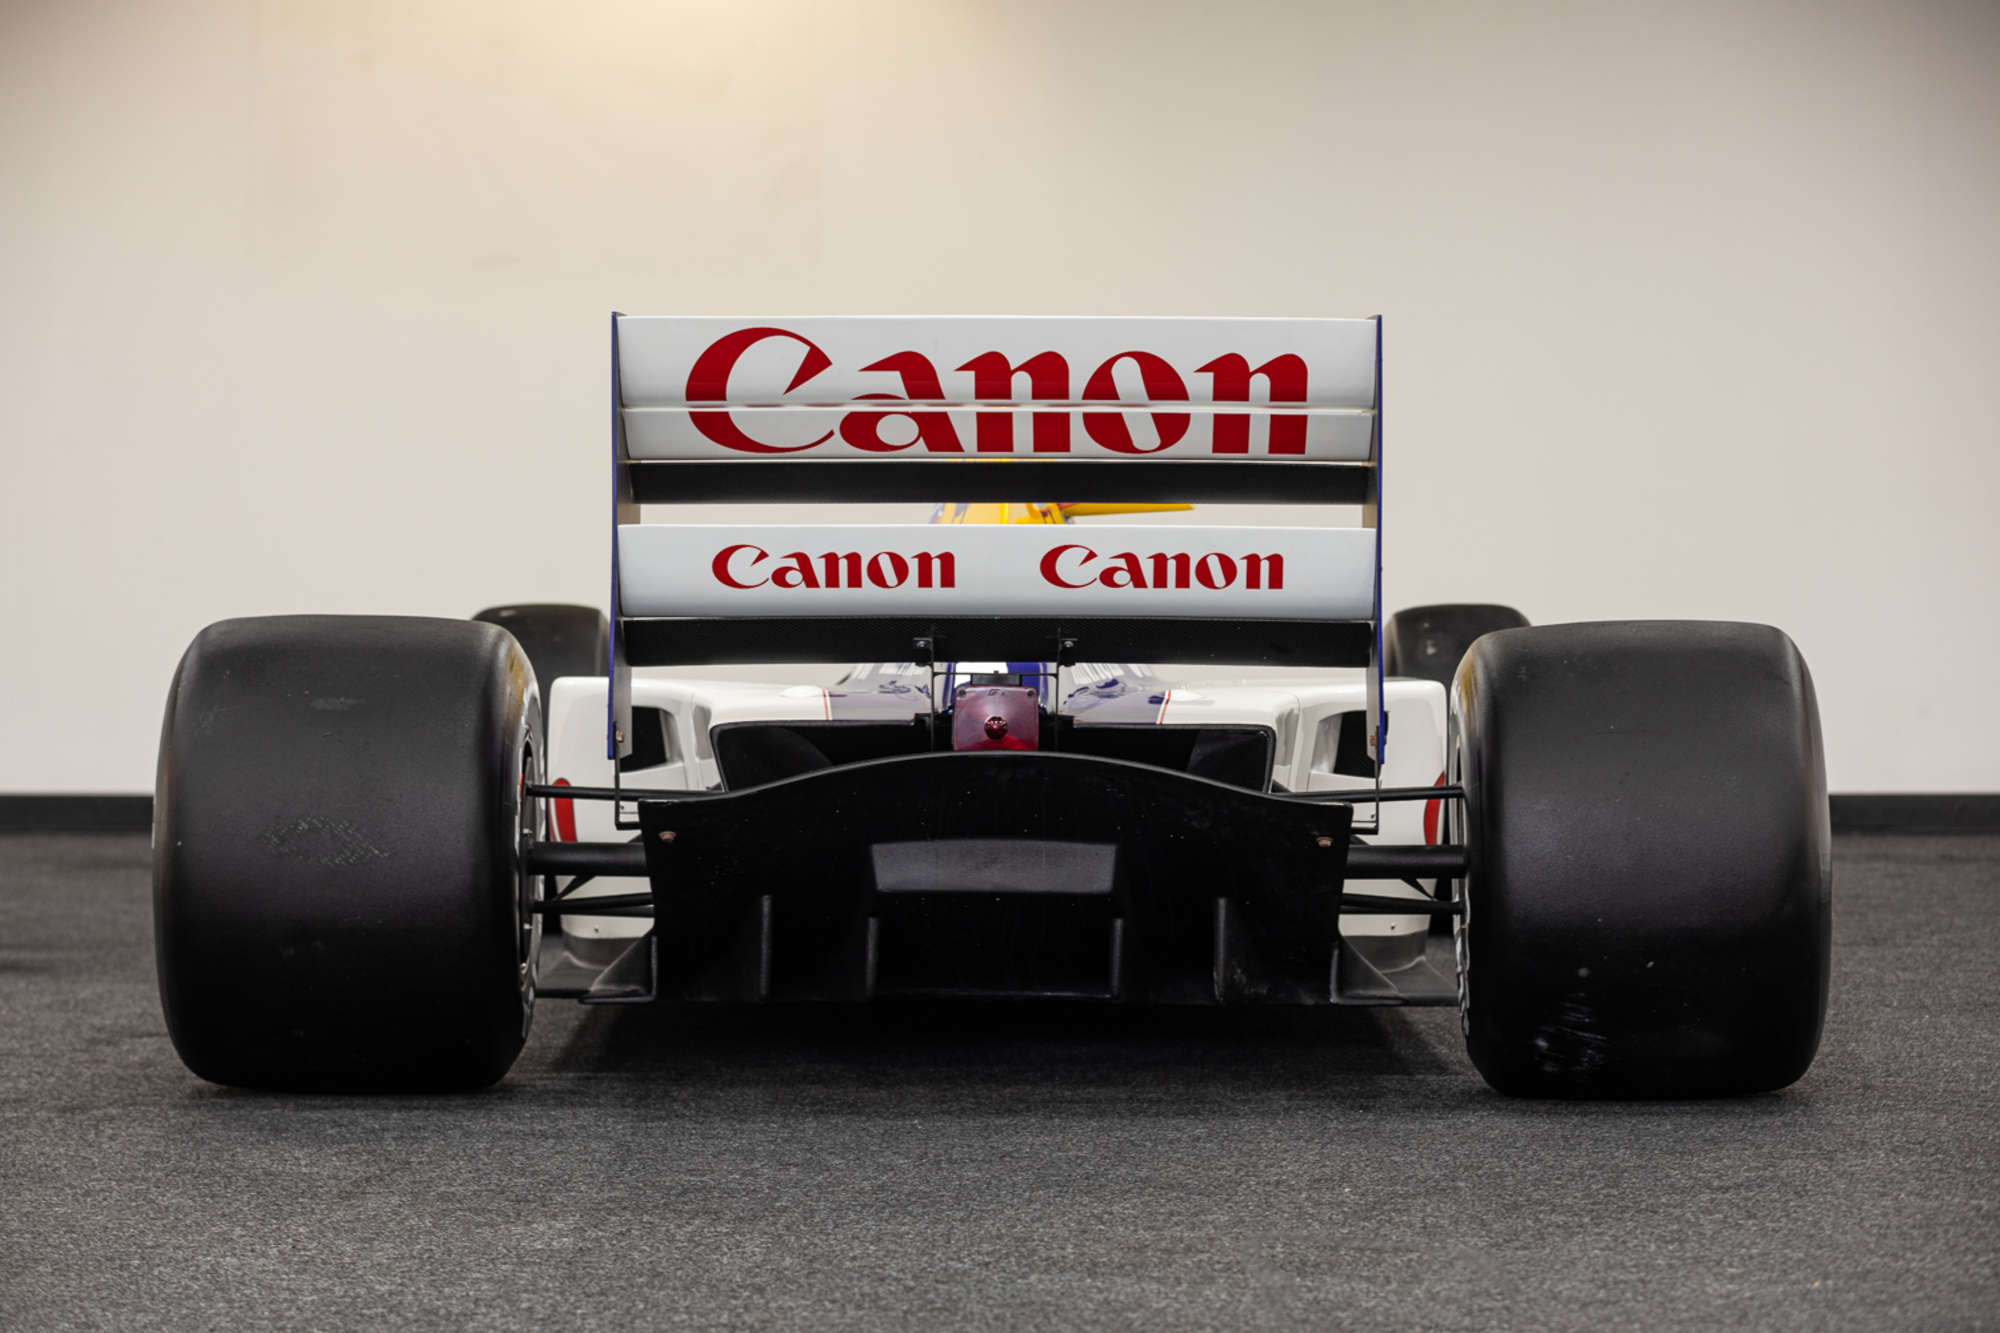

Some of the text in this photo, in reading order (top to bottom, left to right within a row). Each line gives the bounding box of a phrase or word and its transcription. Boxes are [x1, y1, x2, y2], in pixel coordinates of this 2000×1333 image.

[685, 327, 1308, 455] Canon
[712, 544, 956, 589] Canon
[1040, 545, 1284, 590] Canon
